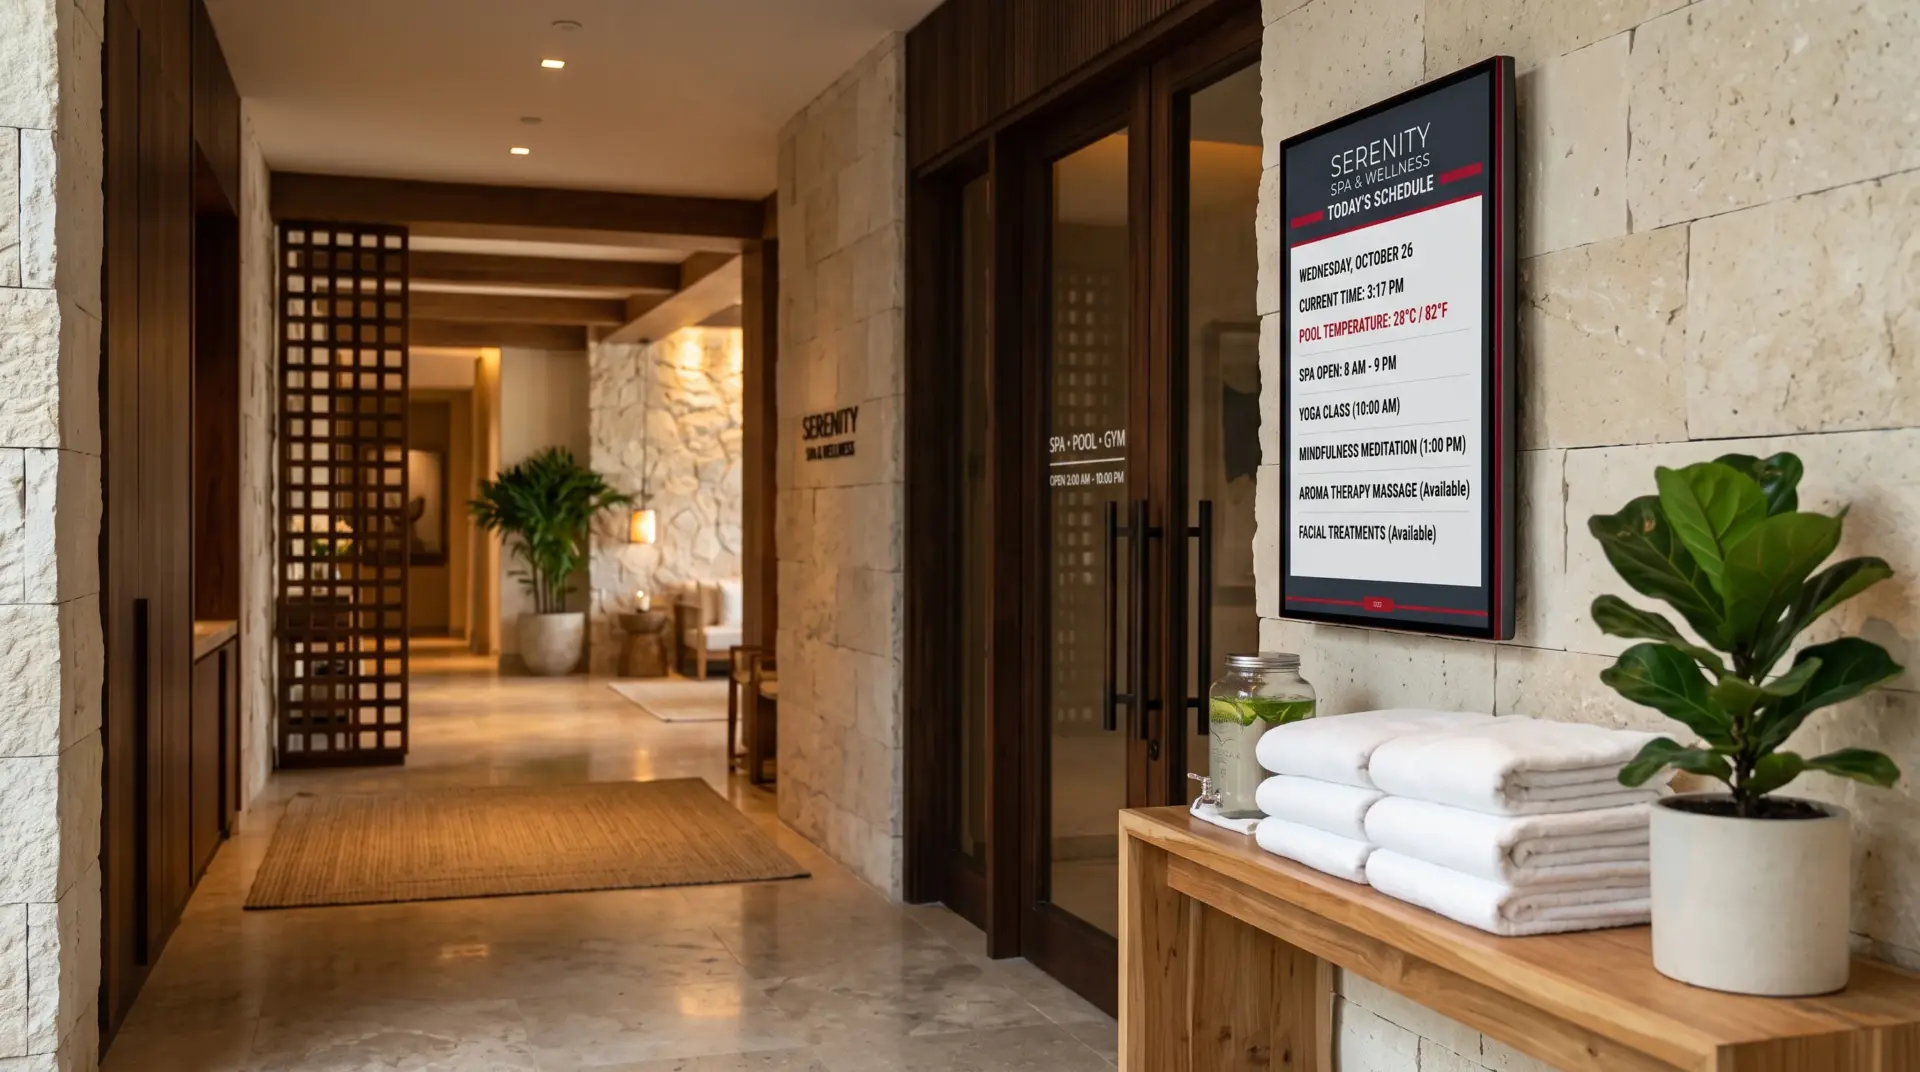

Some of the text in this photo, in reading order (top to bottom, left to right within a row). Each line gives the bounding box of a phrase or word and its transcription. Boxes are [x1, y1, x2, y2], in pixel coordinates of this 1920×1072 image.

[1331, 121, 1431, 178] SERENITY
[1330, 152, 1430, 197] SPA & WELLNESS
[1327, 173, 1434, 221] TODAY'S SCHEDULE
[1299, 242, 1414, 283] WEDNESDAY, OCTOBER 26
[1299, 277, 1404, 313] CURRENT TIME: 3:17 PM
[1299, 301, 1448, 343] POOL TEMPERATURE: 28°C / 82°F
[1299, 367, 1315, 382] SPA
[1316, 363, 1343, 380] OPEN:
[1344, 361, 1350, 376] 8
[1351, 359, 1366, 375] AM
[1374, 357, 1380, 372] 9
[1382, 355, 1397, 371] PM
[802, 405, 858, 440] SERENITY
[1299, 397, 1401, 421] YOGA CLASS (10:00 AM)
[1049, 436, 1066, 453] SPA
[1072, 433, 1098, 451] POOL
[1104, 429, 1126, 448] GYM
[1299, 434, 1466, 461] MINDFULNESS MEDITATION (1:00 PM)
[1049, 474, 1066, 486] OPEN
[1081, 473, 1091, 485] AM
[1113, 470, 1125, 484] PM
[1299, 479, 1470, 501] AROMA THERAPY MASSAGE (Available)
[1299, 524, 1437, 545] FACIAL TREATMENTS (Available)
